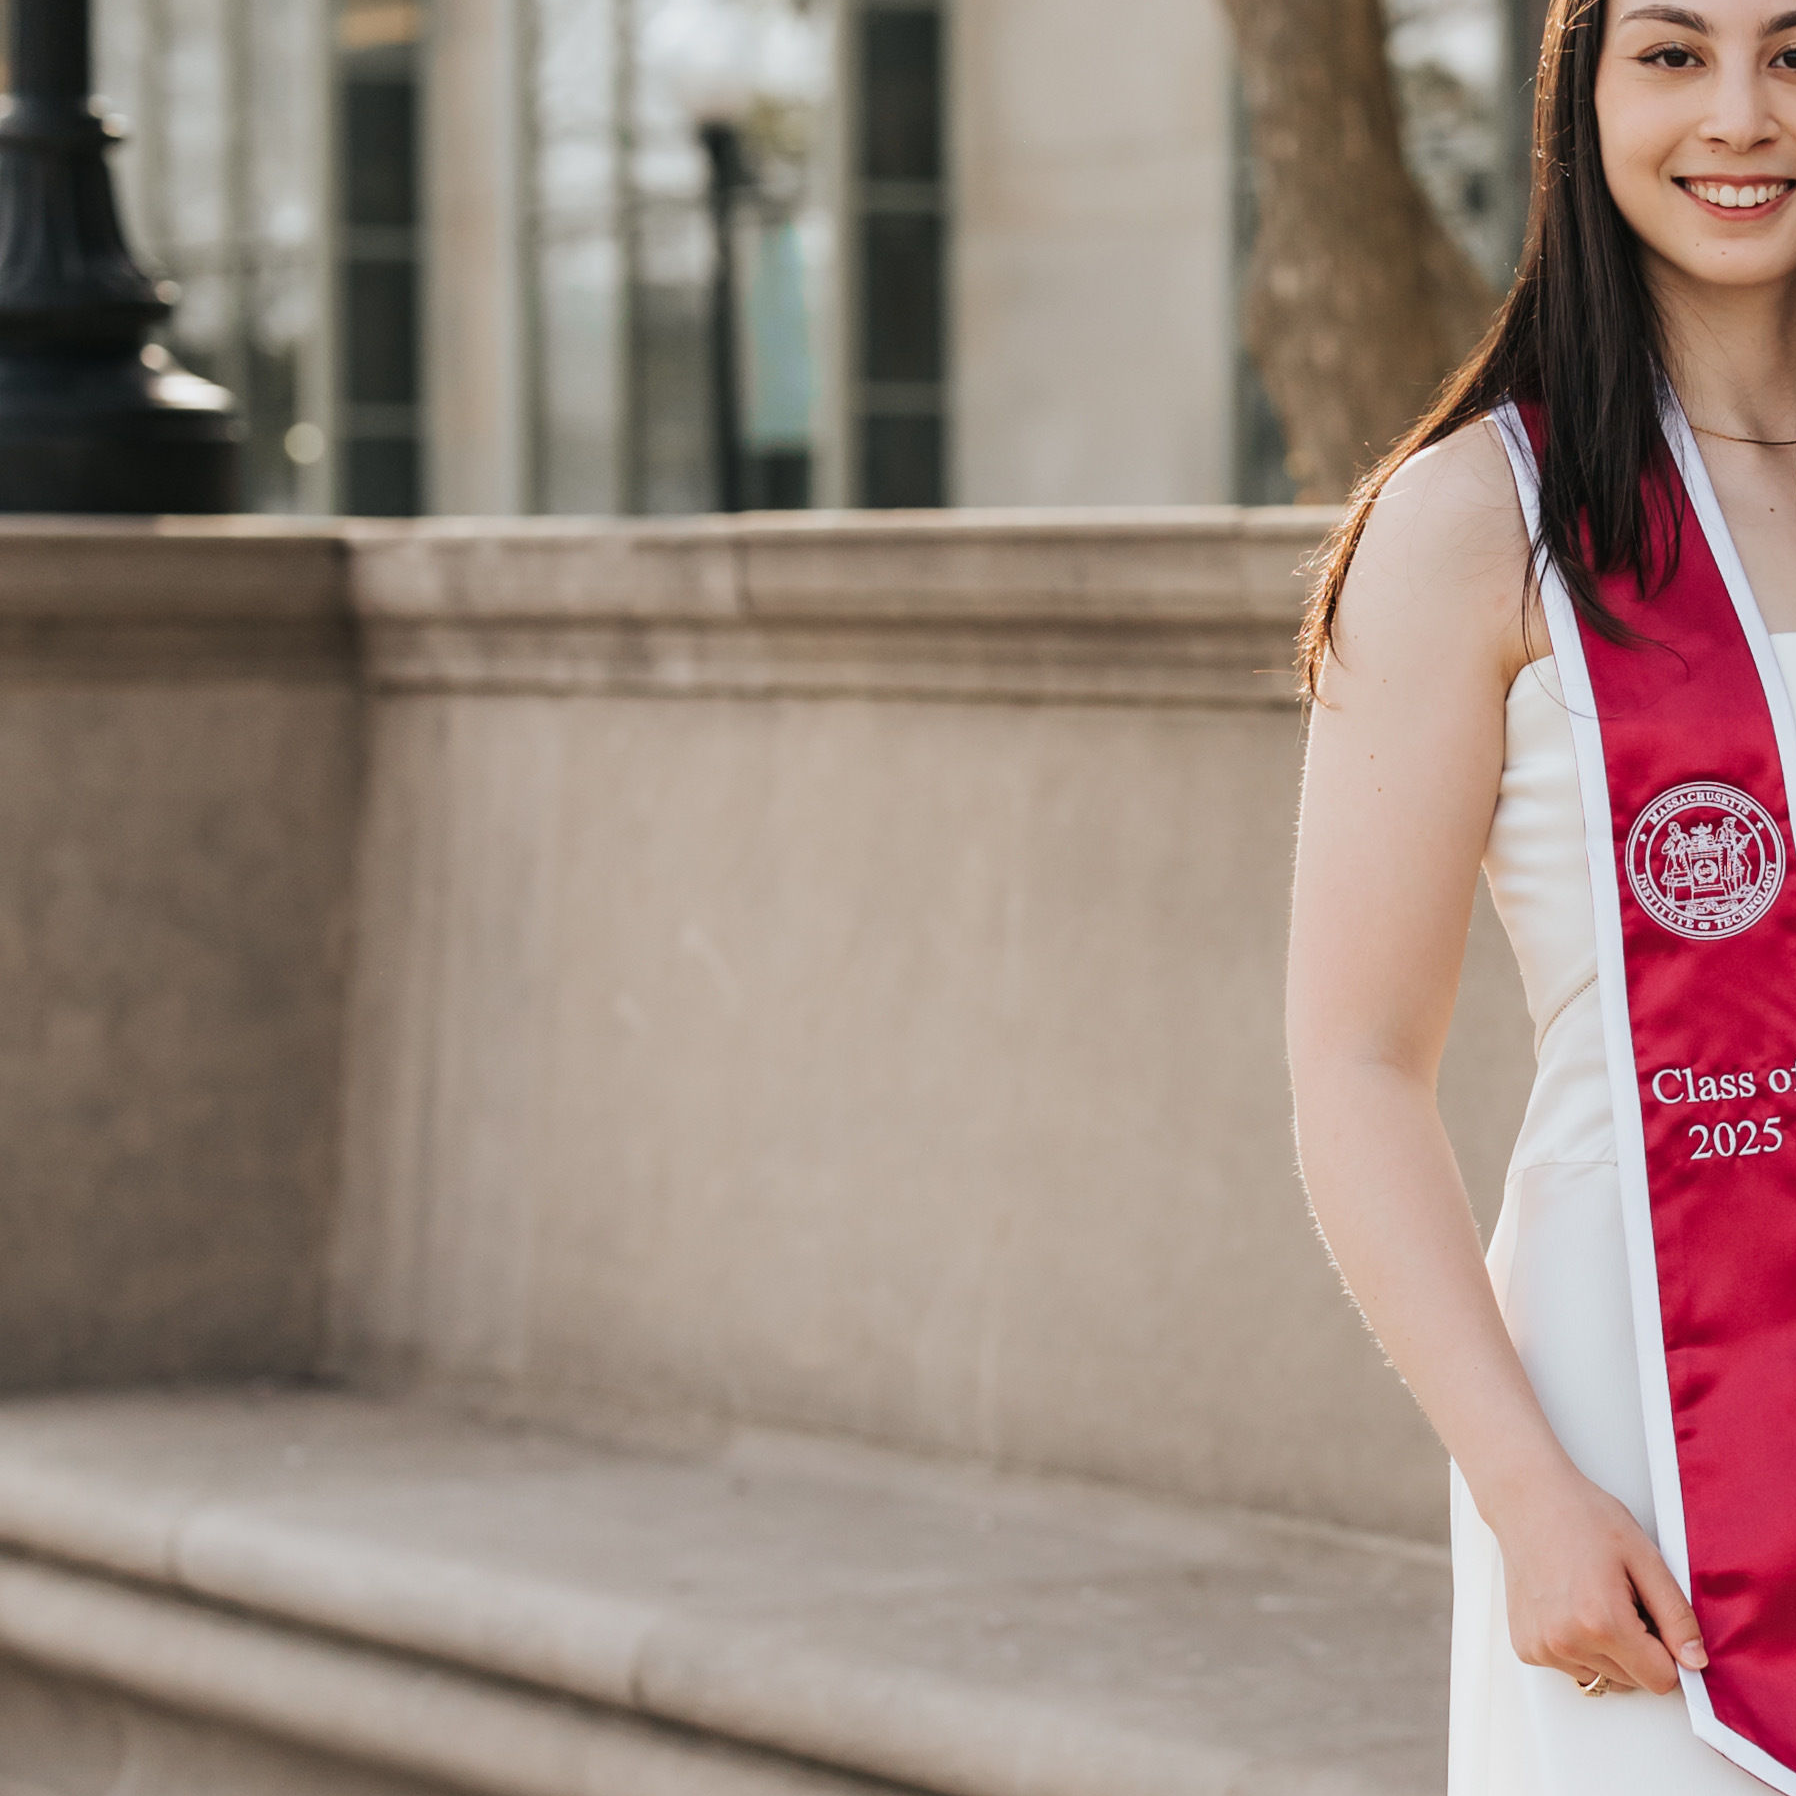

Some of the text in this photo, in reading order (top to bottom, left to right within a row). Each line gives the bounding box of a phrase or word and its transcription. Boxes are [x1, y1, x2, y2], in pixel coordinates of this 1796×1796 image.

[1648, 792, 1751, 825] MASSACHUSETTS
[1636, 861, 1776, 931] INSTITUTE OF TECHNOLOGY
[1652, 1067, 1756, 1104] Class
[1688, 1116, 1783, 1160] 2025
